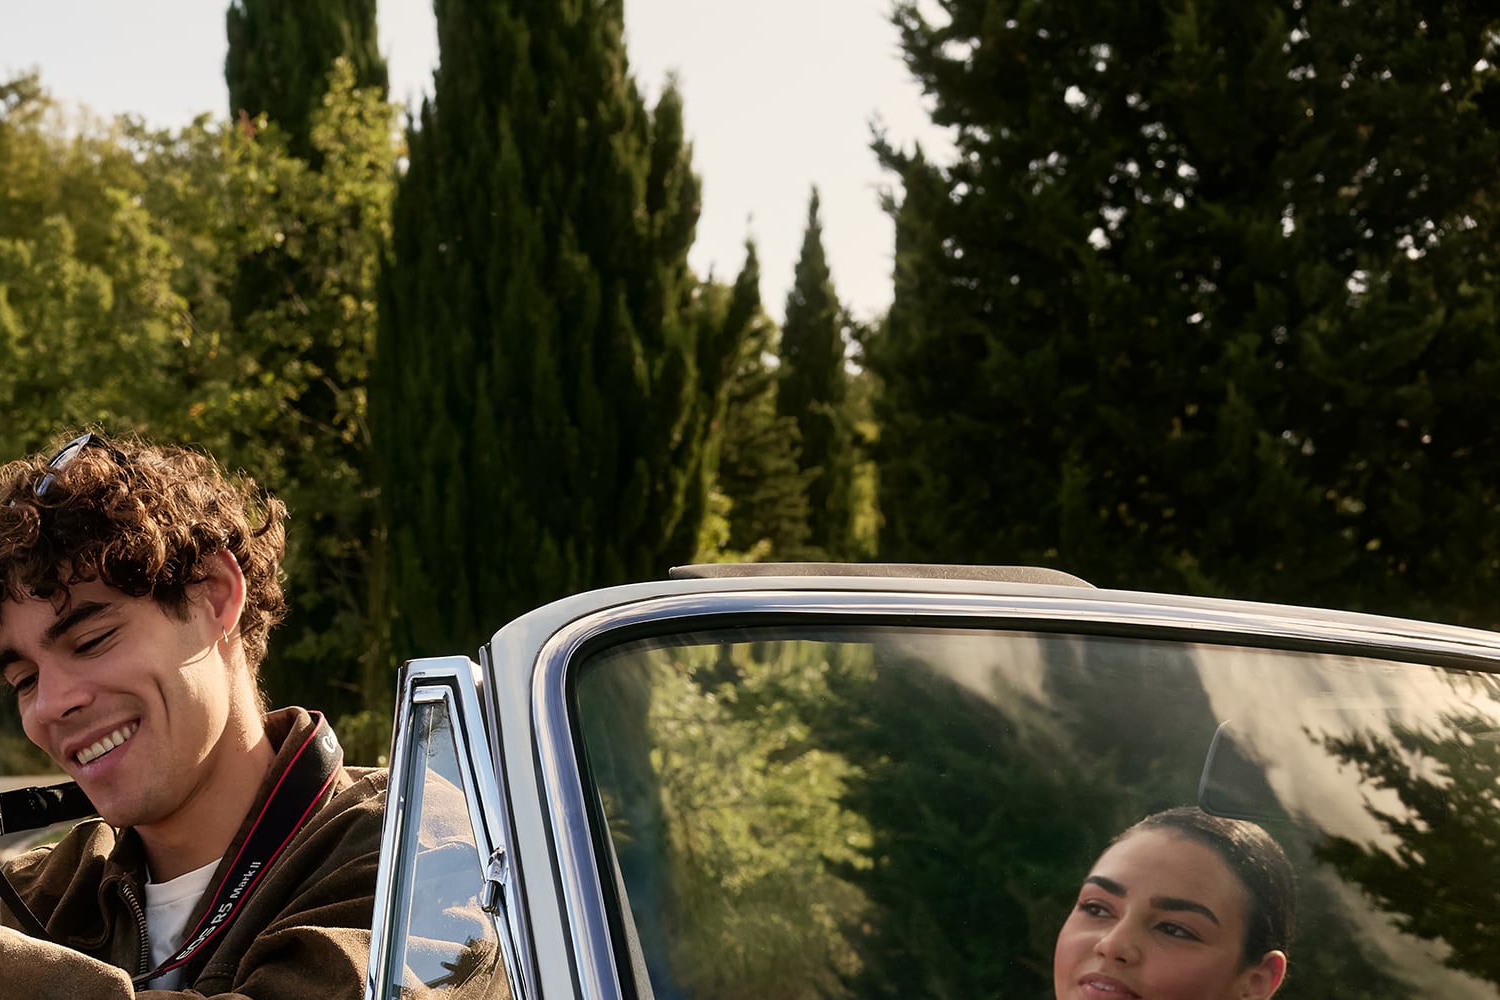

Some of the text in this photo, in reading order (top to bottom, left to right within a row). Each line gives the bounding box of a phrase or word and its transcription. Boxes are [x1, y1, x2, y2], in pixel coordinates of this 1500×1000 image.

[175, 926, 216, 960] EOS
[210, 902, 233, 924] R5
[229, 870, 256, 898] Mark
